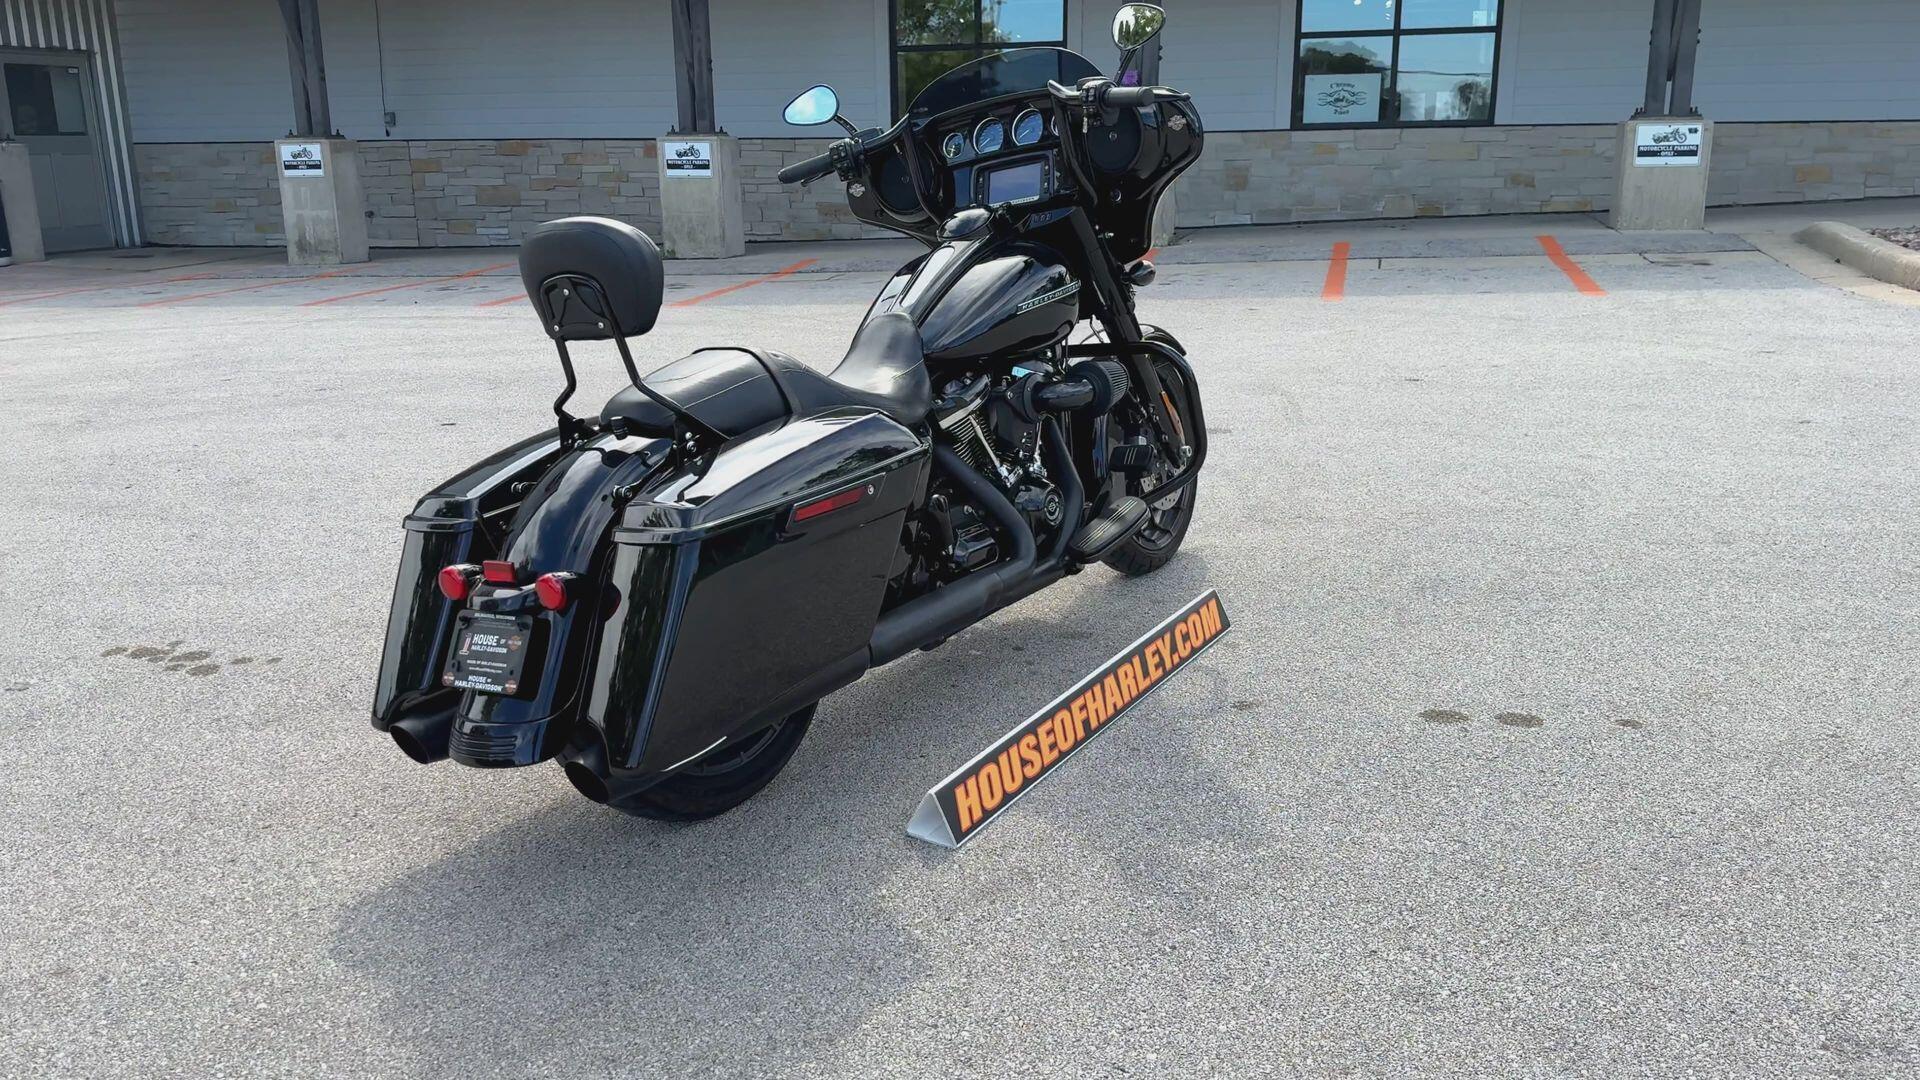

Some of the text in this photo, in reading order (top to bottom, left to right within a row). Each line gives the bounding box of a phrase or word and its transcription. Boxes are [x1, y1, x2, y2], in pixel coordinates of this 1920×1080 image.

[472, 633, 499, 646] HOUSE
[454, 679, 504, 692] HARLEY-DAVIDSON
[468, 675, 487, 683] HOUSE
[954, 598, 1222, 833] HOUSEOFHARLEY.COM
